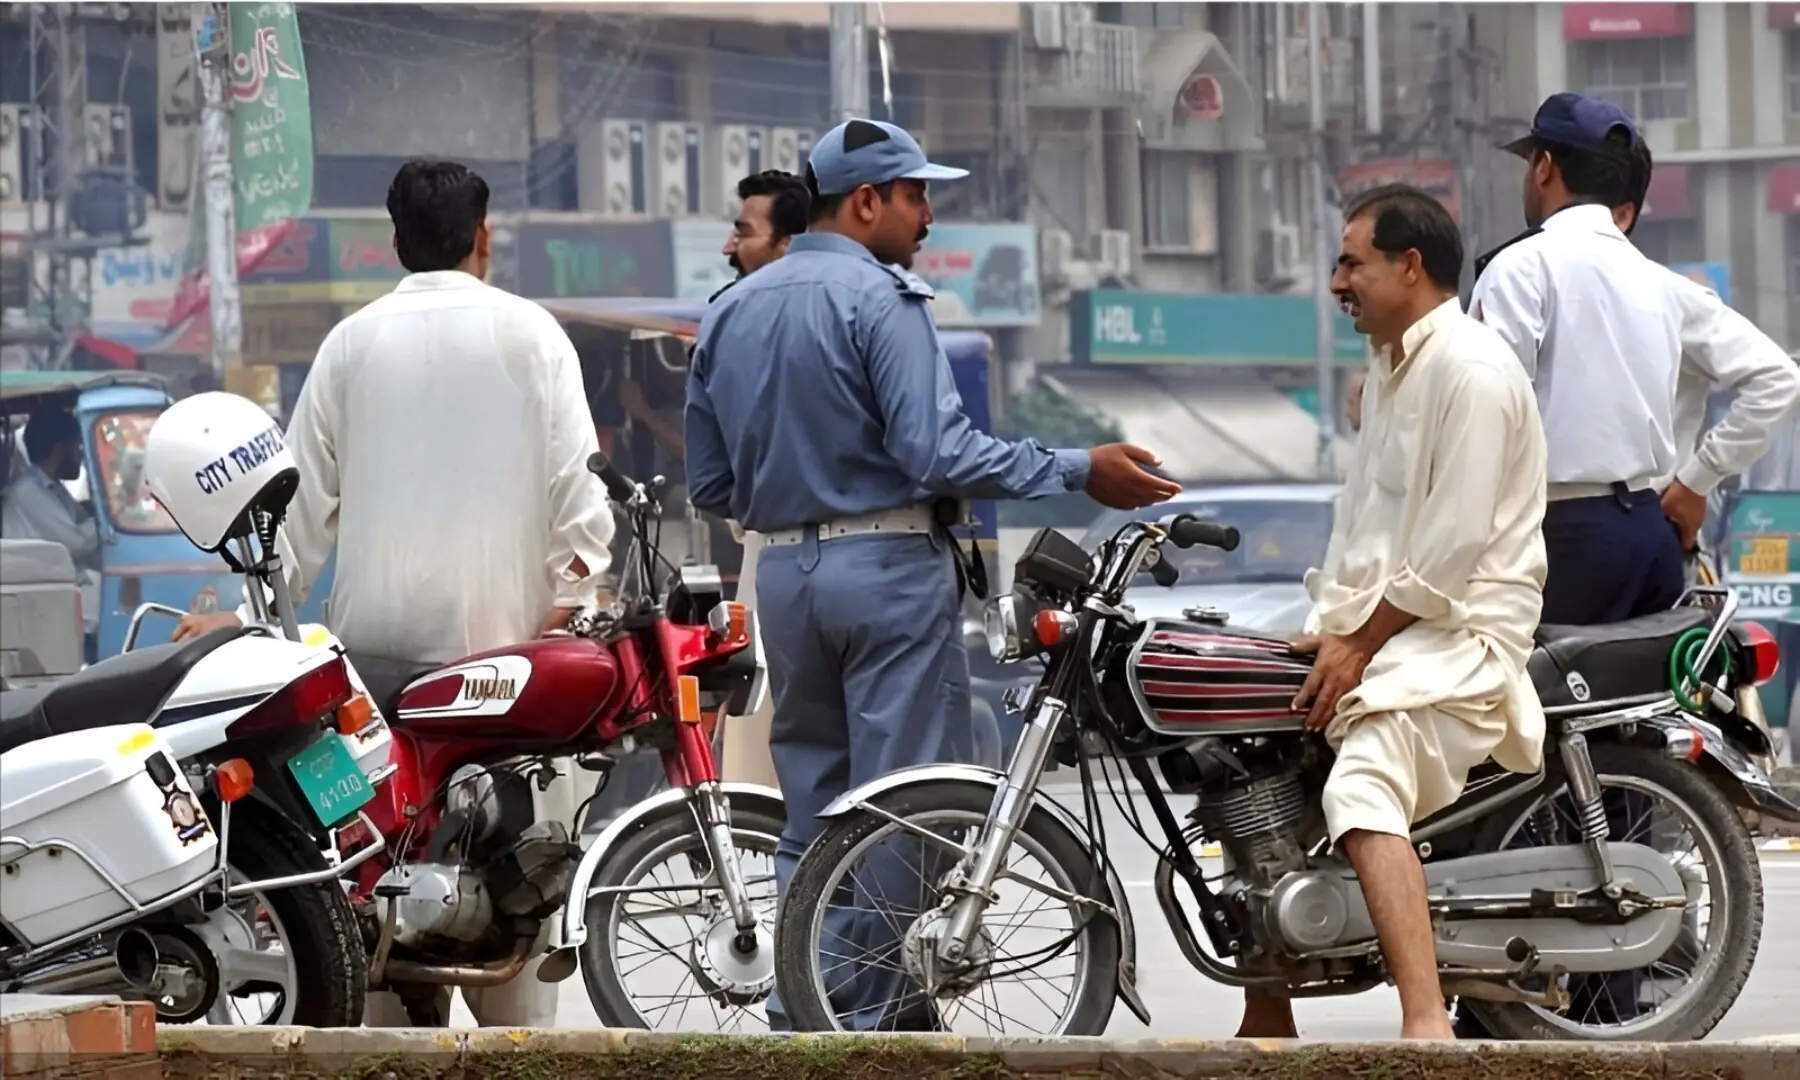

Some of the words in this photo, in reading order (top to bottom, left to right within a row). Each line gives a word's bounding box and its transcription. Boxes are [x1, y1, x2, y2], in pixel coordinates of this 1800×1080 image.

[1095, 305, 1142, 343] HBL
[195, 457, 232, 494] CITY
[1735, 584, 1792, 606] CNG
